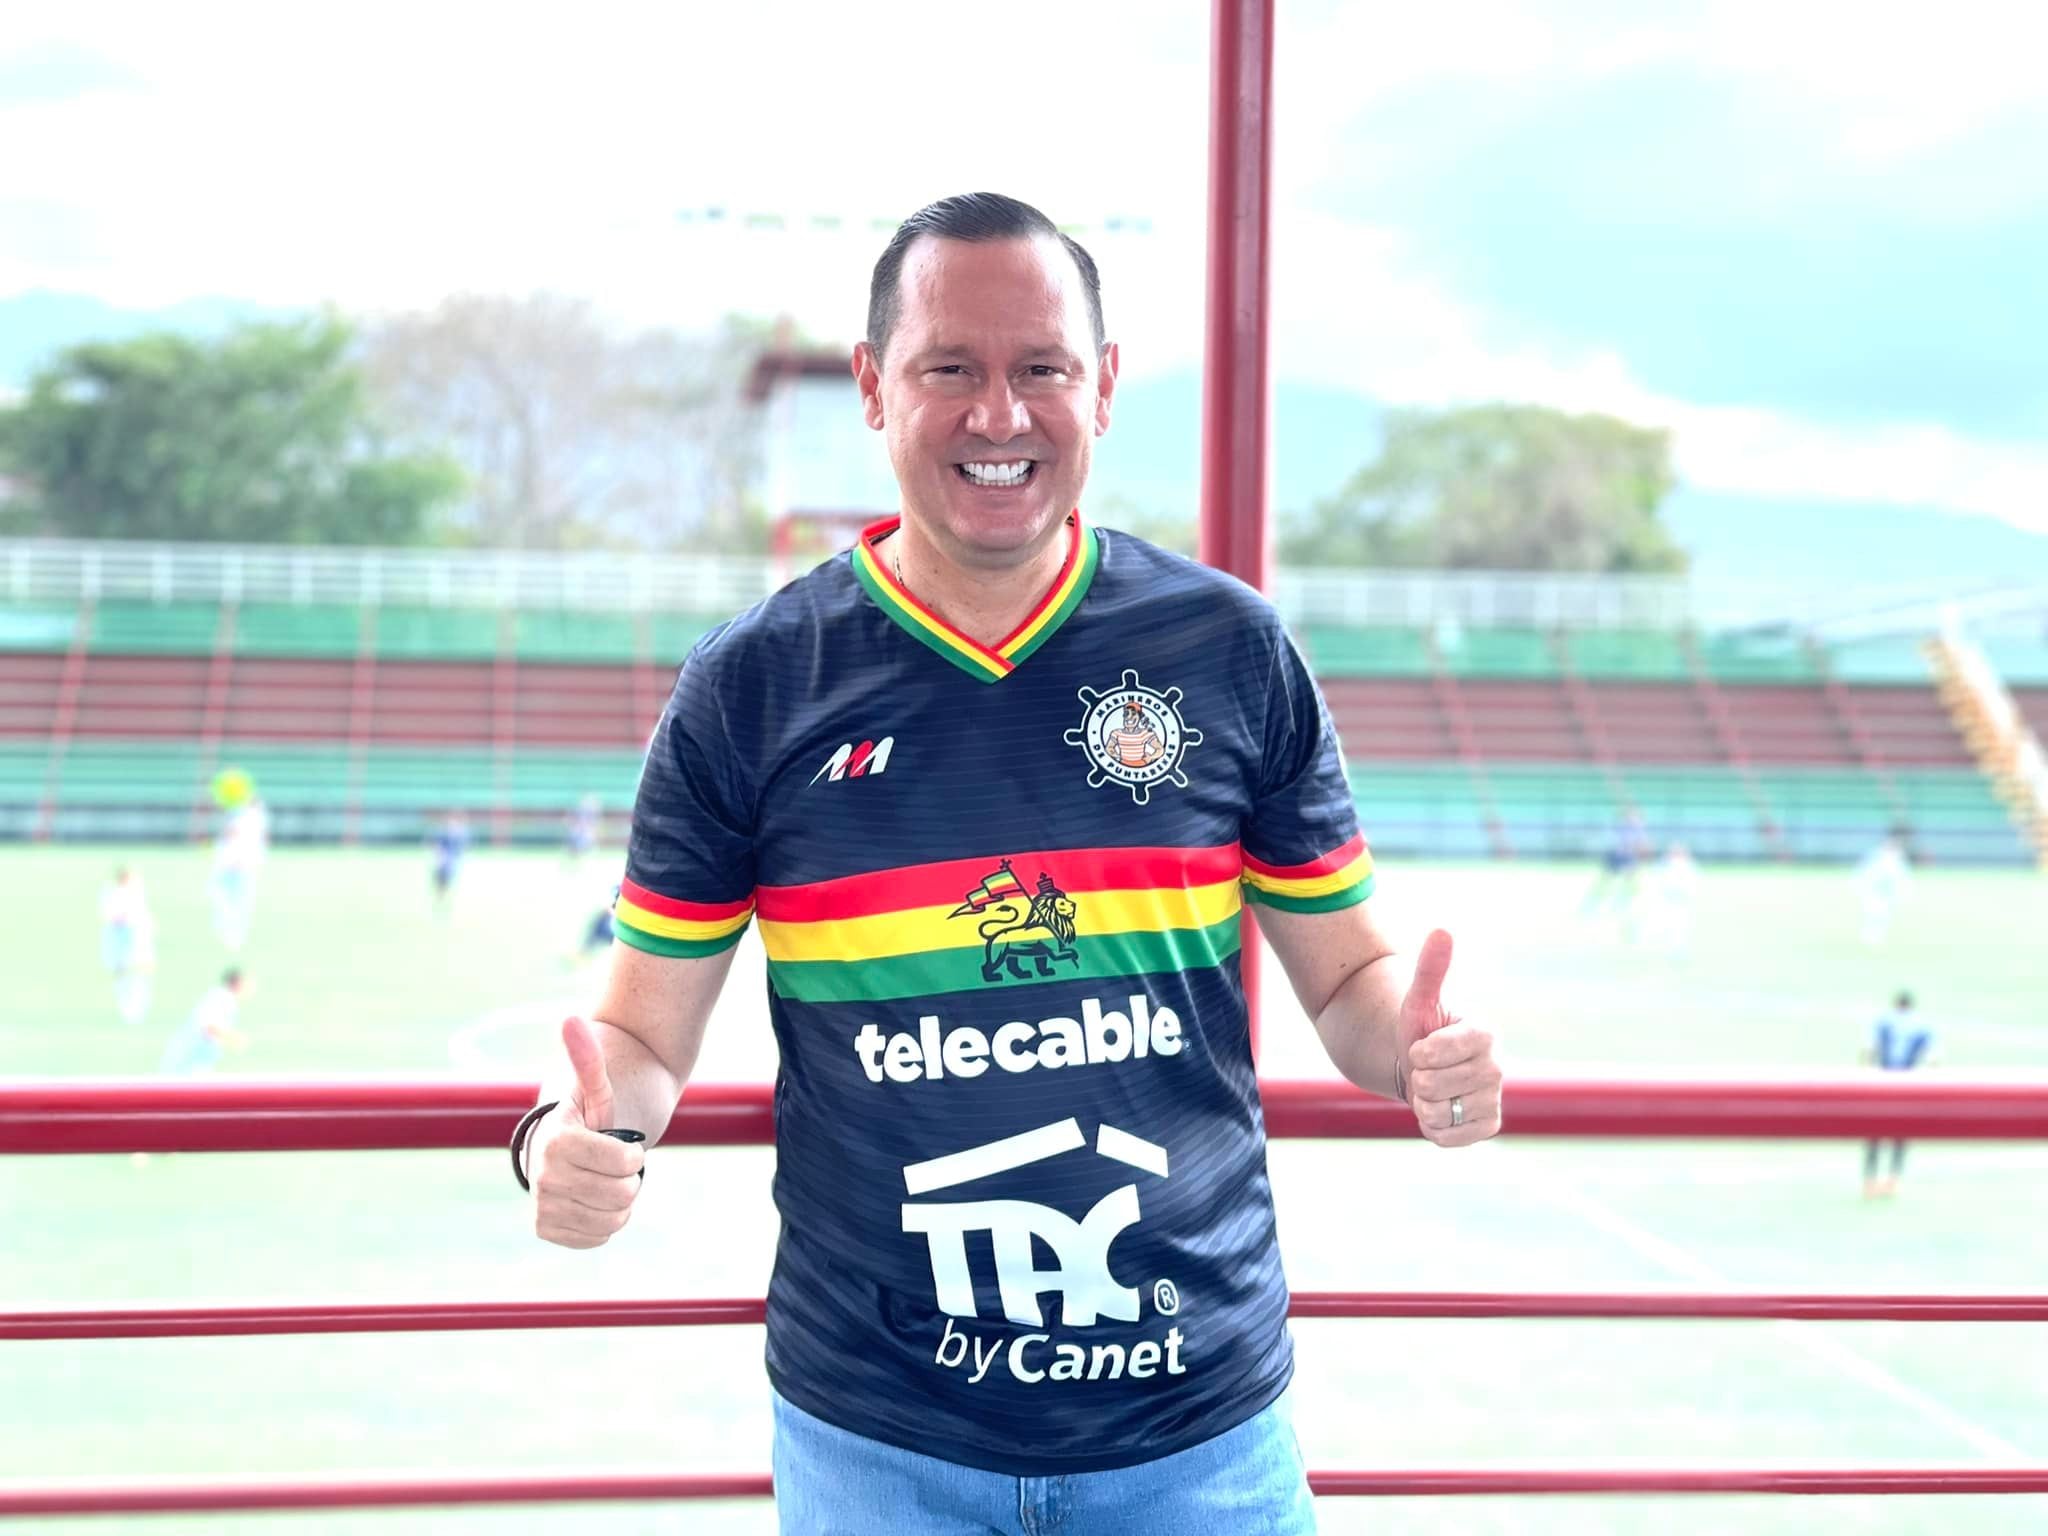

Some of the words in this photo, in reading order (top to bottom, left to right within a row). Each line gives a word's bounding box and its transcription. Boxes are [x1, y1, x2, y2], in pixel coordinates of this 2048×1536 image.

[854, 994, 1183, 1083] telecable
[935, 1318, 1004, 1384] by
[1007, 1325, 1187, 1384] Canet
